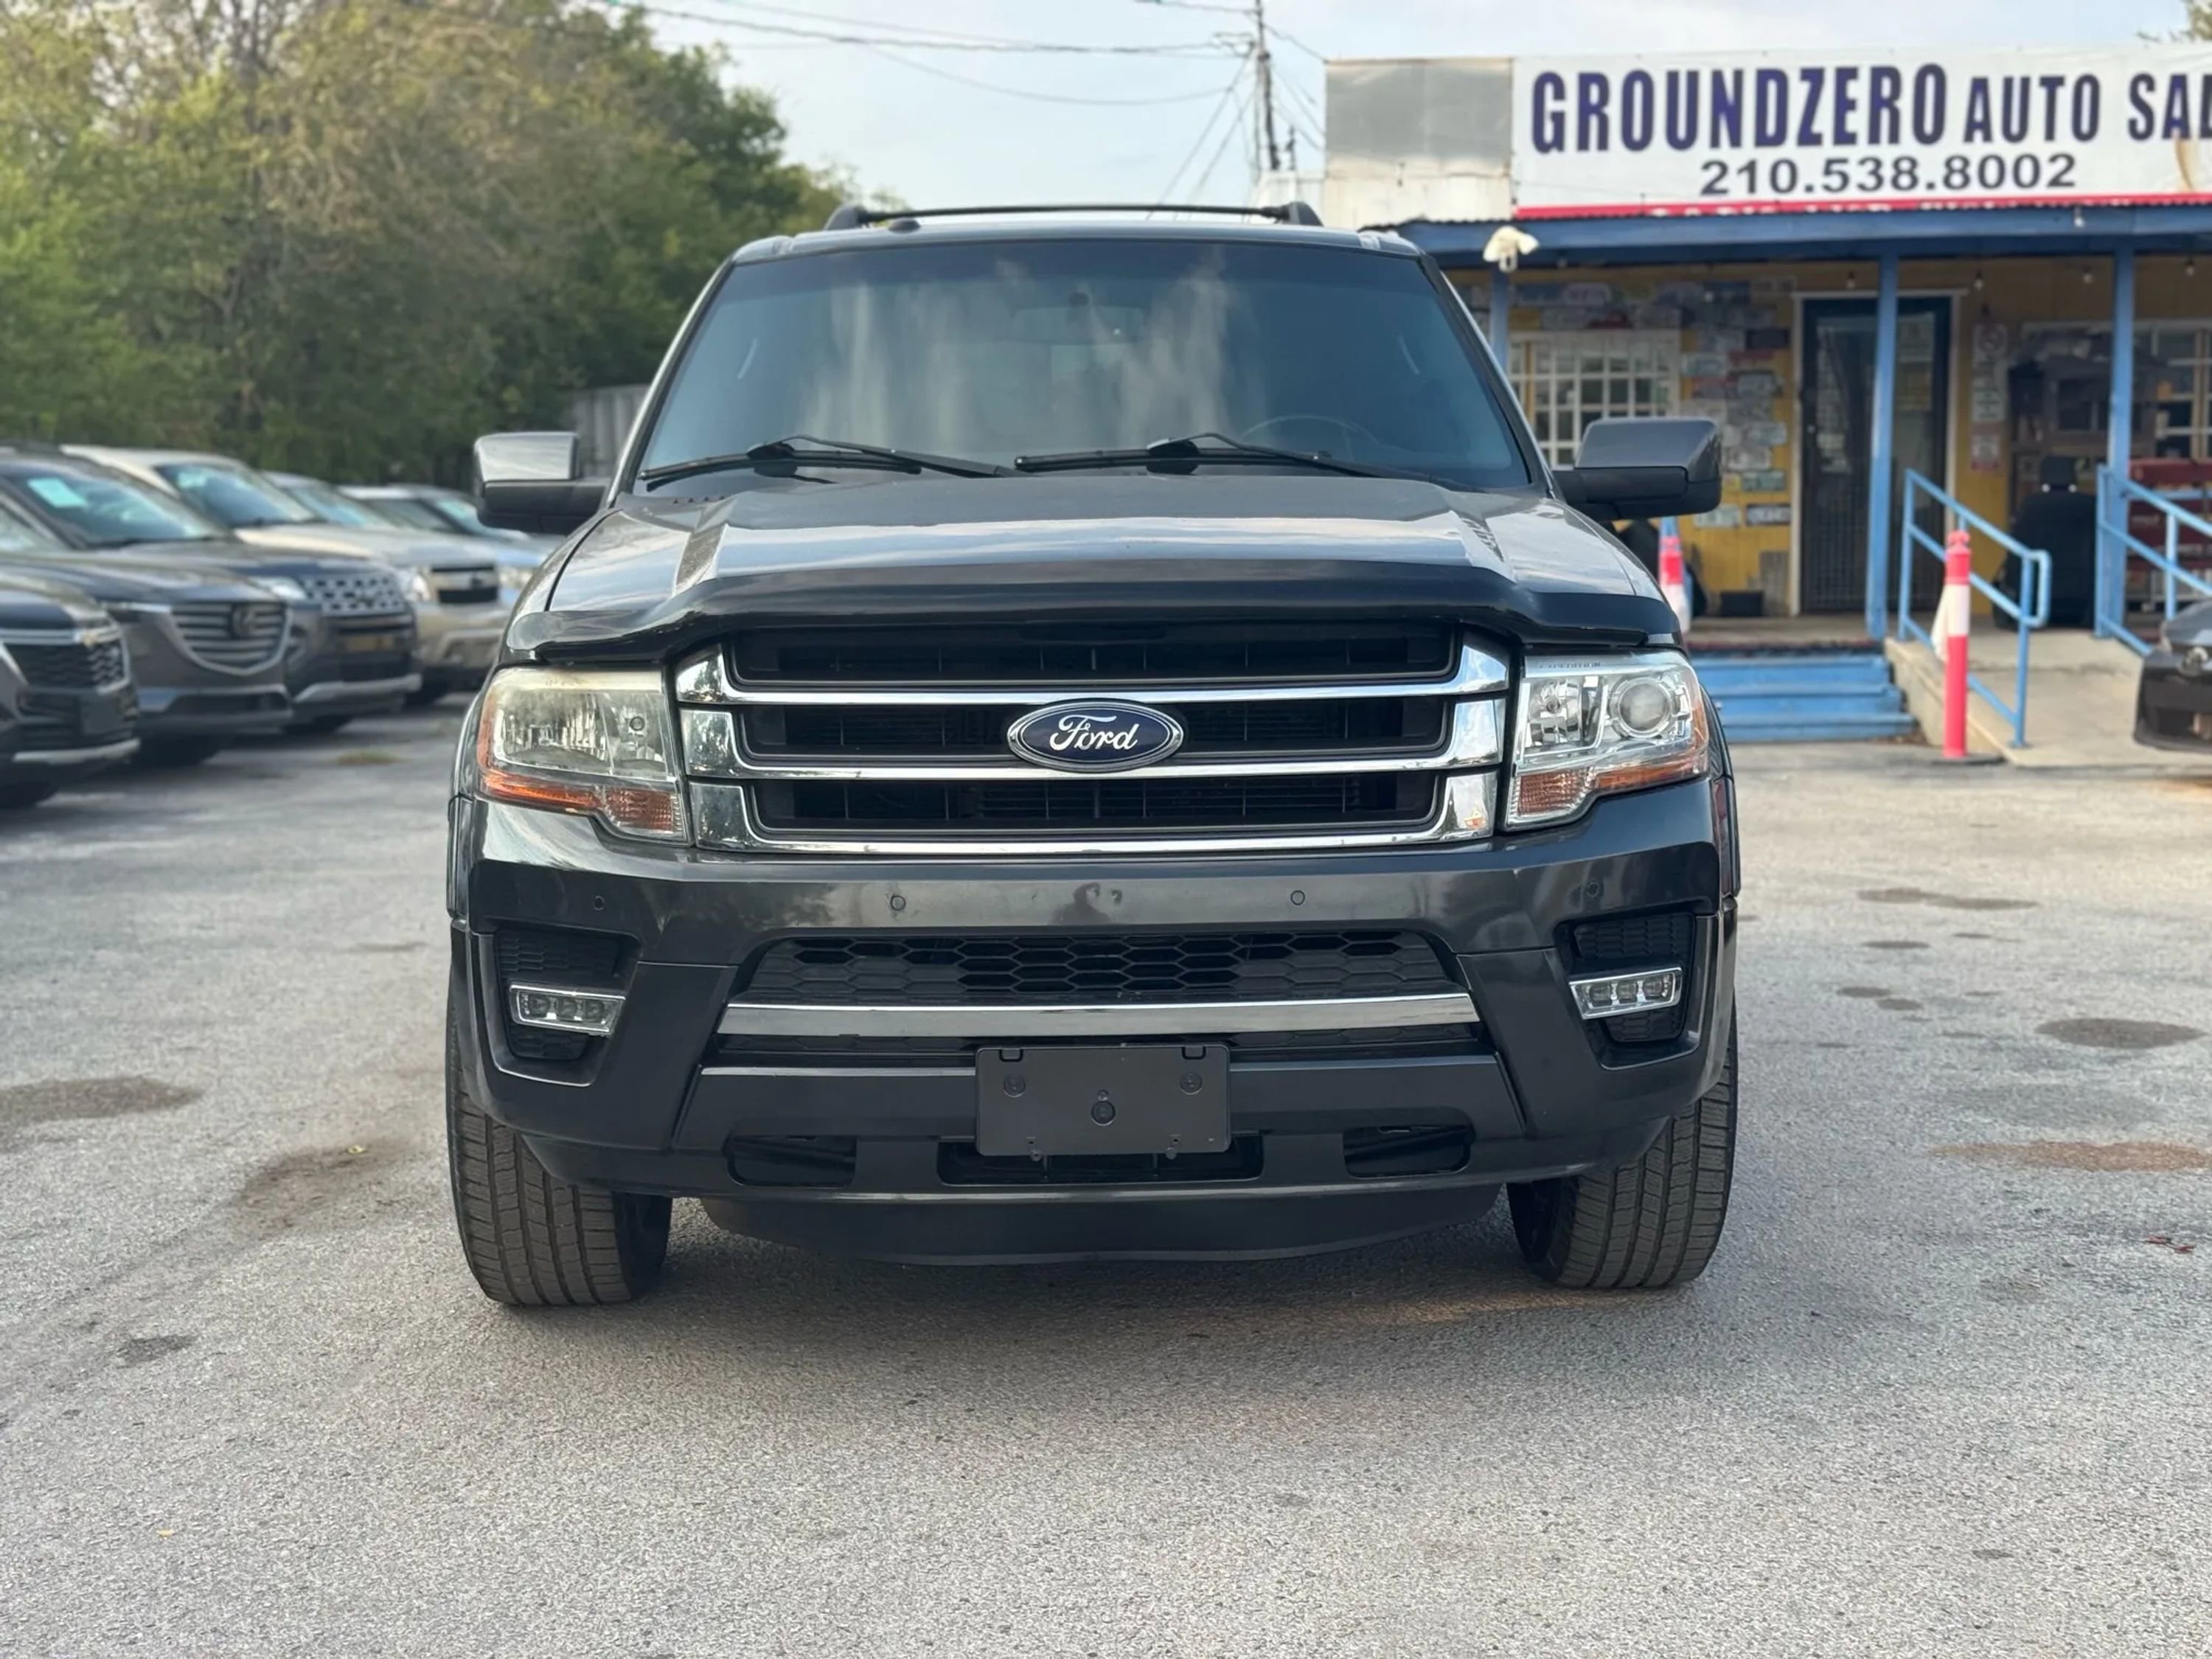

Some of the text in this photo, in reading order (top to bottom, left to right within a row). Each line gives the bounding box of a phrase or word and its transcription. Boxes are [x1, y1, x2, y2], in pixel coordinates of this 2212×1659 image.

[1531, 63, 1947, 153] GROUNDZERO
[1963, 73, 2101, 143] AUTO
[1700, 153, 2076, 195] 210.538.8002
[1049, 714, 1140, 751] Ford
